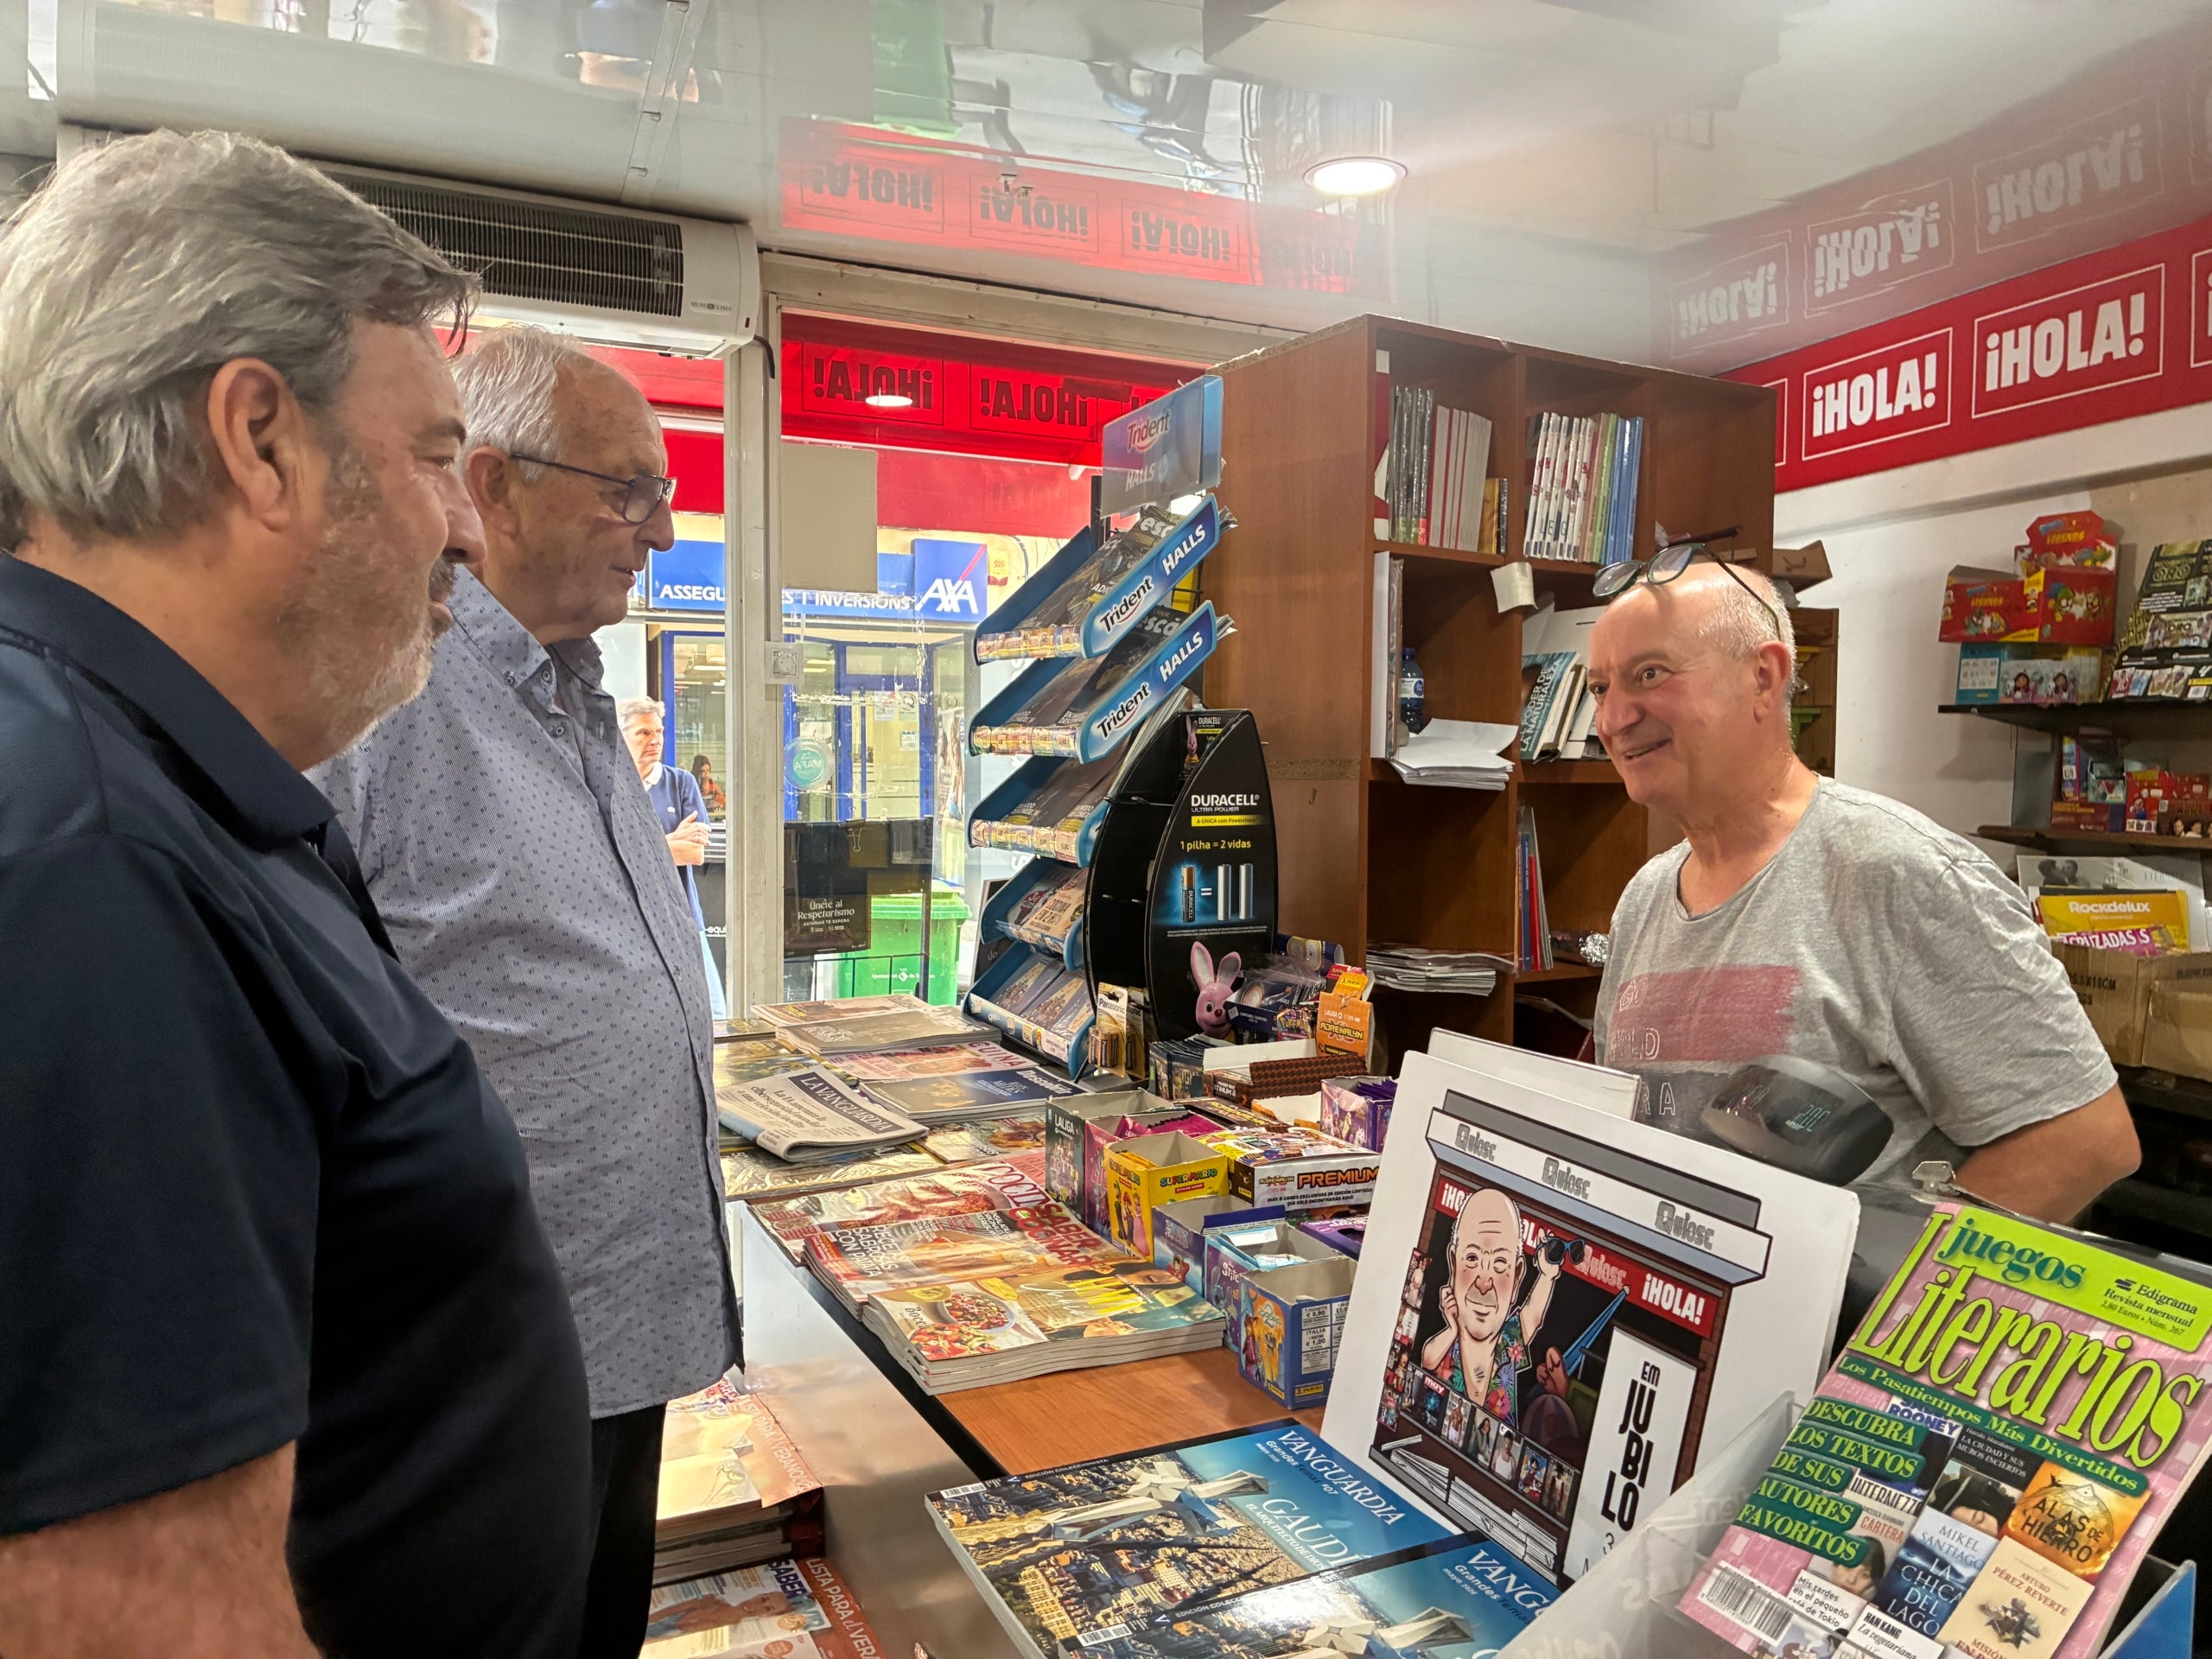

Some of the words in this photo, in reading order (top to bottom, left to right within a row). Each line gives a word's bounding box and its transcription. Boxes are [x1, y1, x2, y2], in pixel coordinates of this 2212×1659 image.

[1986, 292, 2146, 393] ¡HOLA!
[1812, 352, 1938, 437] ¡HOLA!
[1127, 410, 1171, 452] Trident
[915, 577, 980, 614] AXA
[1100, 576, 1154, 634] Trident
[1161, 523, 1206, 576] HALLS
[1097, 683, 1152, 741] Trident
[1158, 632, 1205, 683] HALLS
[1186, 840, 1211, 853] pilha
[1220, 840, 1227, 849] 2
[1227, 839, 1251, 849] vidas
[798, 908, 855, 921] Respeturismo
[810, 898, 833, 911] Únete
[835, 899, 843, 909] al
[2068, 900, 2152, 914] Rockdelux
[1320, 1022, 1364, 1039] ADRENALYN
[801, 1077, 818, 1092] LA
[813, 1084, 894, 1132] VANGUARDIA
[1054, 1114, 1075, 1135] LALIGA
[1160, 1173, 1189, 1188] SUPER
[1187, 1167, 1218, 1184] MARIO
[1297, 1166, 1380, 1191] PREMIUM
[836, 1230, 860, 1252] CON
[1008, 1206, 1093, 1266] COCINAR
[1034, 1204, 1103, 1250] SABER
[1938, 1217, 2088, 1292] juegos
[1641, 1272, 1707, 1327] ¡HOLA!
[2104, 1288, 2144, 1310] Revista
[2145, 1305, 2195, 1328] mensual
[2118, 1306, 2140, 1320] Euros
[2136, 1284, 2198, 1315] Edigrama
[1306, 1327, 1326, 1336] ITALIA
[1850, 1211, 2205, 1469] Literarios
[1426, 1378, 1446, 1395] muy
[1618, 1379, 1657, 1434] JU
[1804, 1399, 1916, 1446] DESCUBRA
[1838, 1355, 1865, 1379] Los
[1869, 1367, 1983, 1426] Pasatiempos
[1984, 1415, 2026, 1443] Más
[2030, 1434, 2139, 1491] Divertidos
[1887, 1403, 1961, 1436] ROONEY
[1025, 1469, 1054, 1479] EDICIÓN
[1054, 1458, 1109, 1473] COLECCIONISTA
[1266, 1440, 1299, 1467] Grandes
[1624, 1435, 1654, 1490] BI
[1771, 1450, 1808, 1472] DE
[1808, 1461, 1845, 1488] SUS
[1789, 1424, 1826, 1450] LOS
[1828, 1433, 1919, 1479] TEXTOS
[1972, 1438, 2004, 1459] CIUDAD
[2010, 1456, 2025, 1467] SUS
[1985, 1454, 2027, 1478] INCIERTOS
[1277, 1429, 1406, 1526] VANGUARDIA
[1601, 1470, 1639, 1533] LO
[1755, 1478, 1856, 1526] AUTORES
[2032, 1496, 2090, 1534] ALAS
[2087, 1527, 2105, 1543] DE
[1255, 1508, 1300, 1550] ARQUITECTO
[1737, 1503, 1861, 1563] FAVORITOS
[1860, 1516, 1905, 1545] CARTERA
[1938, 1524, 1980, 1553] MIKEL
[2020, 1516, 2094, 1565] HIERRO
[1919, 1530, 1986, 1570] SANTIAGO
[1442, 1567, 1462, 1584] mayo
[1455, 1564, 1500, 1600] Grandes
[1900, 1563, 1963, 1605] CHICA
[1929, 1557, 1953, 1581] LA
[2020, 1572, 2051, 1593] ARTURO
[805, 1557, 836, 1588] LISTA
[823, 1585, 855, 1621] PARA
[1792, 1587, 1804, 1597] en
[1804, 1592, 1814, 1601] el
[1814, 1598, 1850, 1620] pequeño
[1798, 1575, 1813, 1590] Mis
[1814, 1585, 1840, 1603] tardes
[1904, 1586, 1939, 1618] DEL
[1992, 1566, 2023, 1591] PÉREZ
[2024, 1586, 2069, 1618] REVERTE
[1805, 1606, 1816, 1617] de
[1817, 1610, 1840, 1629] Tokio
[1857, 1623, 1870, 1636] La
[1863, 1611, 1882, 1630] HAN
[1880, 1620, 1903, 1639] KANG
[1886, 1598, 1941, 1637] LAGO
